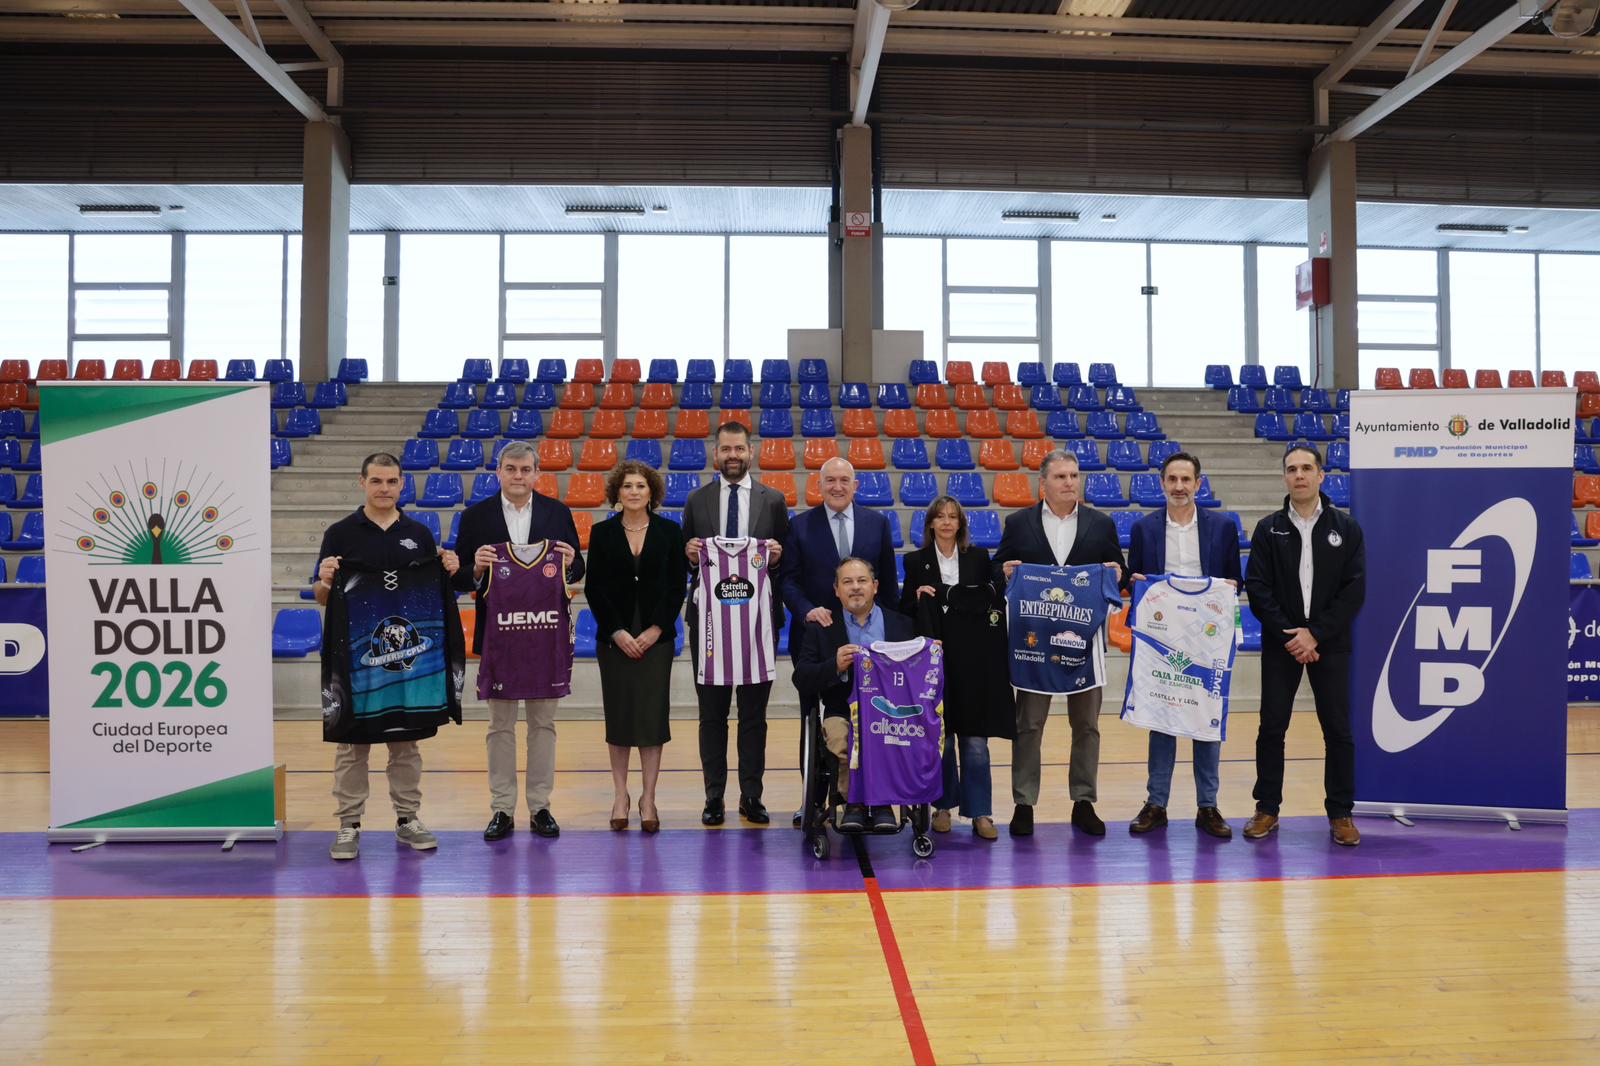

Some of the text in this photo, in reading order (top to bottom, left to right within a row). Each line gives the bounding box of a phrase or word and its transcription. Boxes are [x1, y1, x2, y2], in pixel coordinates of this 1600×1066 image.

[1355, 418, 1571, 435] Ayuntamiento de Valladolid
[1394, 446, 1438, 458] FMD
[721, 582, 749, 591] Estrella
[721, 590, 748, 598] Galicia
[88, 578, 224, 614] VALLA
[497, 610, 559, 625] UEMC
[1020, 600, 1093, 623] ENTREPINARES
[94, 618, 226, 656] DOLID
[1051, 637, 1085, 648] LEVANOVA
[1014, 653, 1045, 663] Valladolid
[90, 660, 228, 708] 2026
[893, 672, 904, 686] 13
[1151, 670, 1202, 687] CAJA RURAL
[1213, 659, 1225, 700] UEMC
[1149, 691, 1176, 702] CASTILLA
[92, 722, 228, 739] Ciudad Europea
[870, 717, 926, 738] aliados
[113, 739, 213, 756] del Deporte
